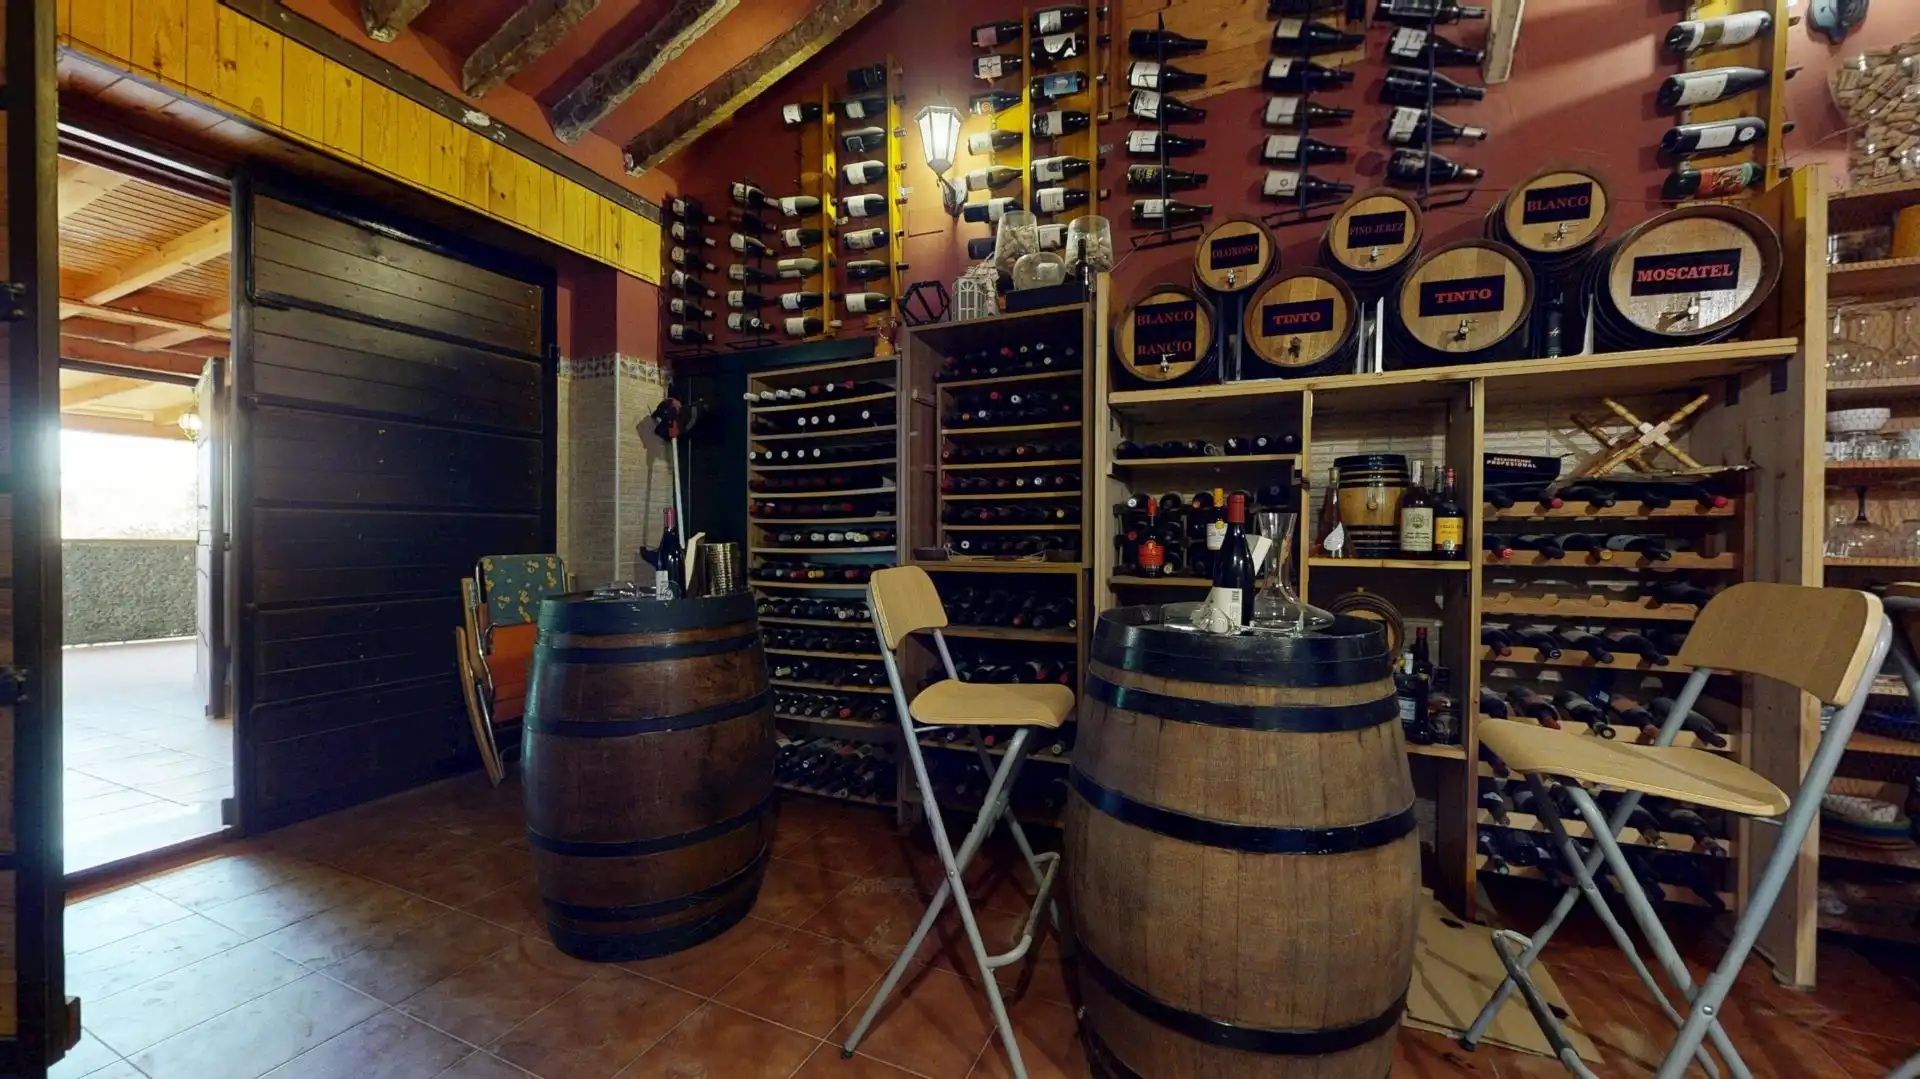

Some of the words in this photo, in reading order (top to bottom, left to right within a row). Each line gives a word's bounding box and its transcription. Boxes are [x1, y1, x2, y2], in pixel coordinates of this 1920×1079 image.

[1527, 195, 1589, 212] BLANCO
[1350, 225, 1372, 236] FINO
[1374, 222, 1404, 234] JEREZ
[1212, 244, 1258, 259] OLOROSO
[1636, 264, 1733, 282] MOSCATEL
[1435, 288, 1492, 303] TINTO
[1137, 310, 1194, 325] BLANCO
[1273, 311, 1321, 325] TINTO
[1137, 341, 1192, 355] RANCIO
[1486, 459, 1537, 469] PROFESIONAL
